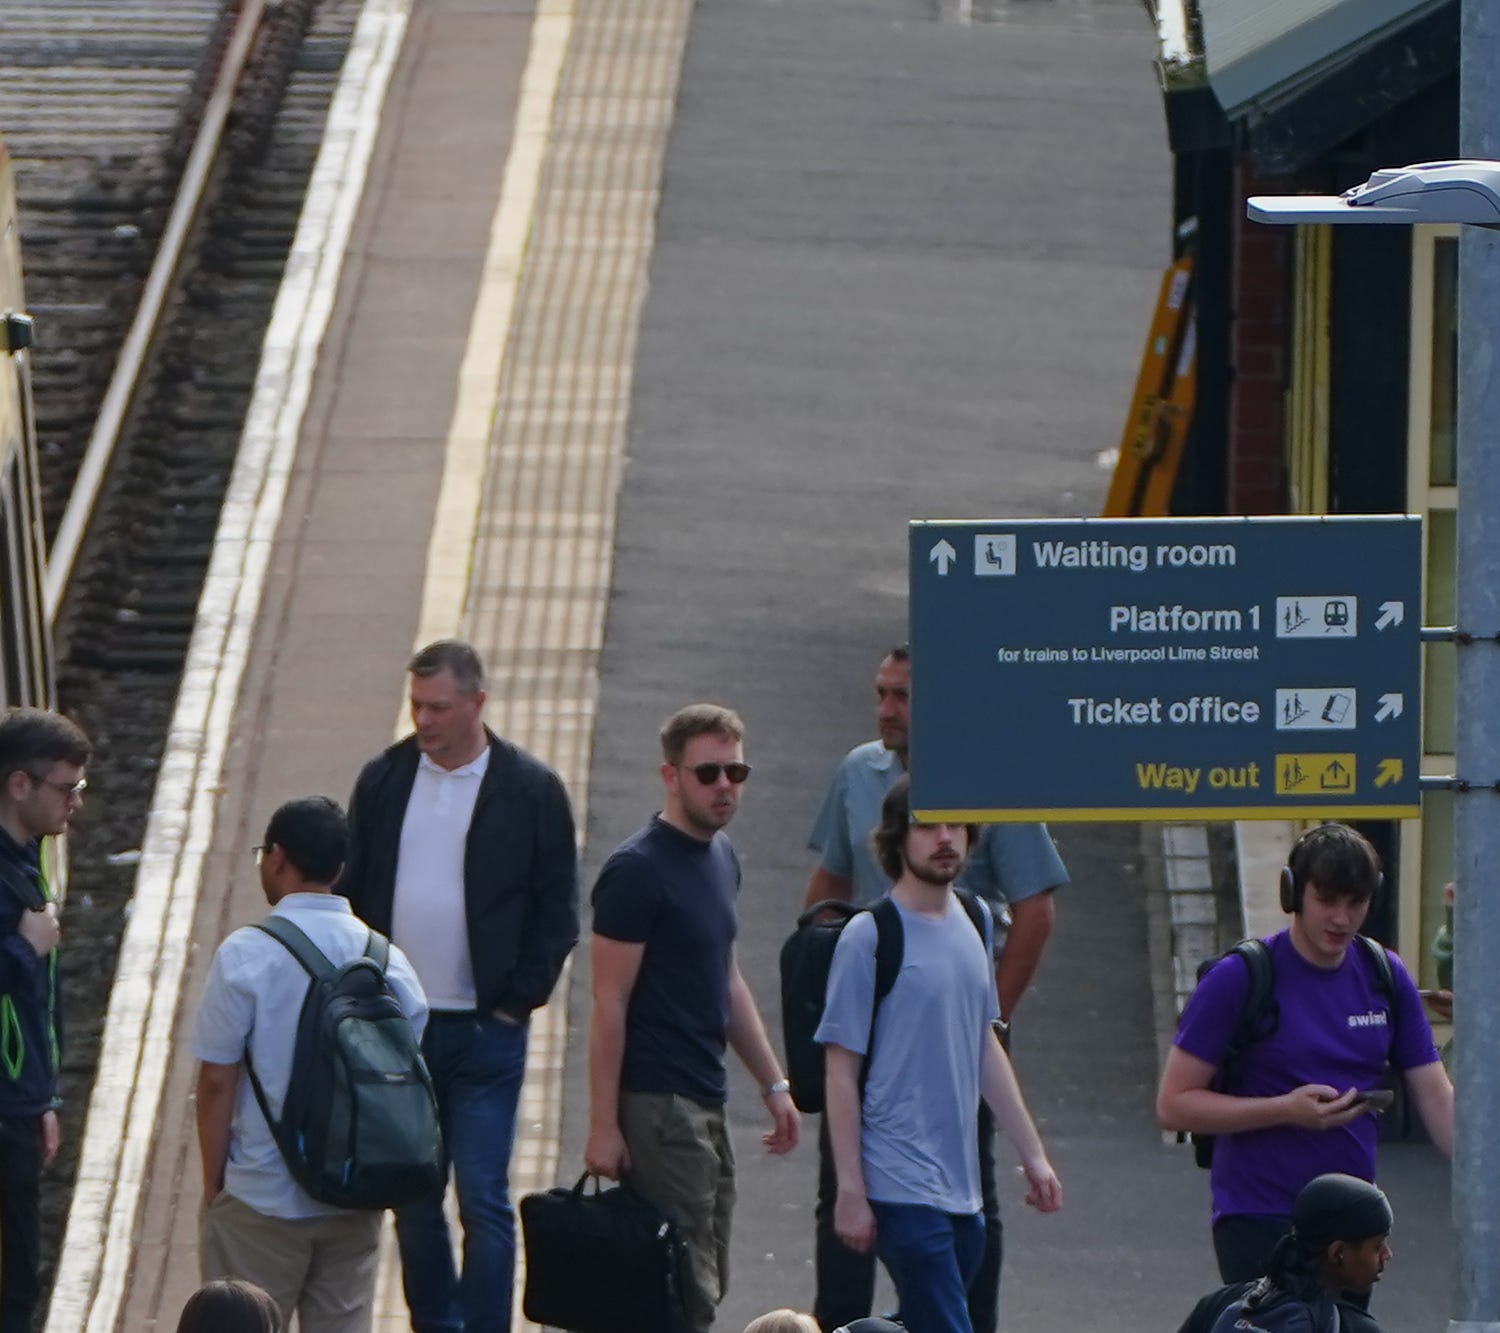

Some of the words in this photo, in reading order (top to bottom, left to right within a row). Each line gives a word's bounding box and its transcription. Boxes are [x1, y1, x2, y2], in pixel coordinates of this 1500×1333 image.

[1033, 541, 1148, 571] Waiting
[1156, 544, 1236, 566] room
[1110, 605, 1242, 632] Platform
[1249, 605, 1260, 630] 1
[998, 647, 1020, 661] for
[1023, 648, 1069, 662] trains
[1072, 648, 1089, 661] to
[1091, 646, 1166, 663] Liverpool
[1168, 646, 1207, 661] Lime
[1210, 646, 1259, 660] Street
[1068, 697, 1162, 724] Ticket
[1169, 696, 1260, 723] office
[1136, 763, 1201, 793] Way
[1209, 762, 1259, 788] out
